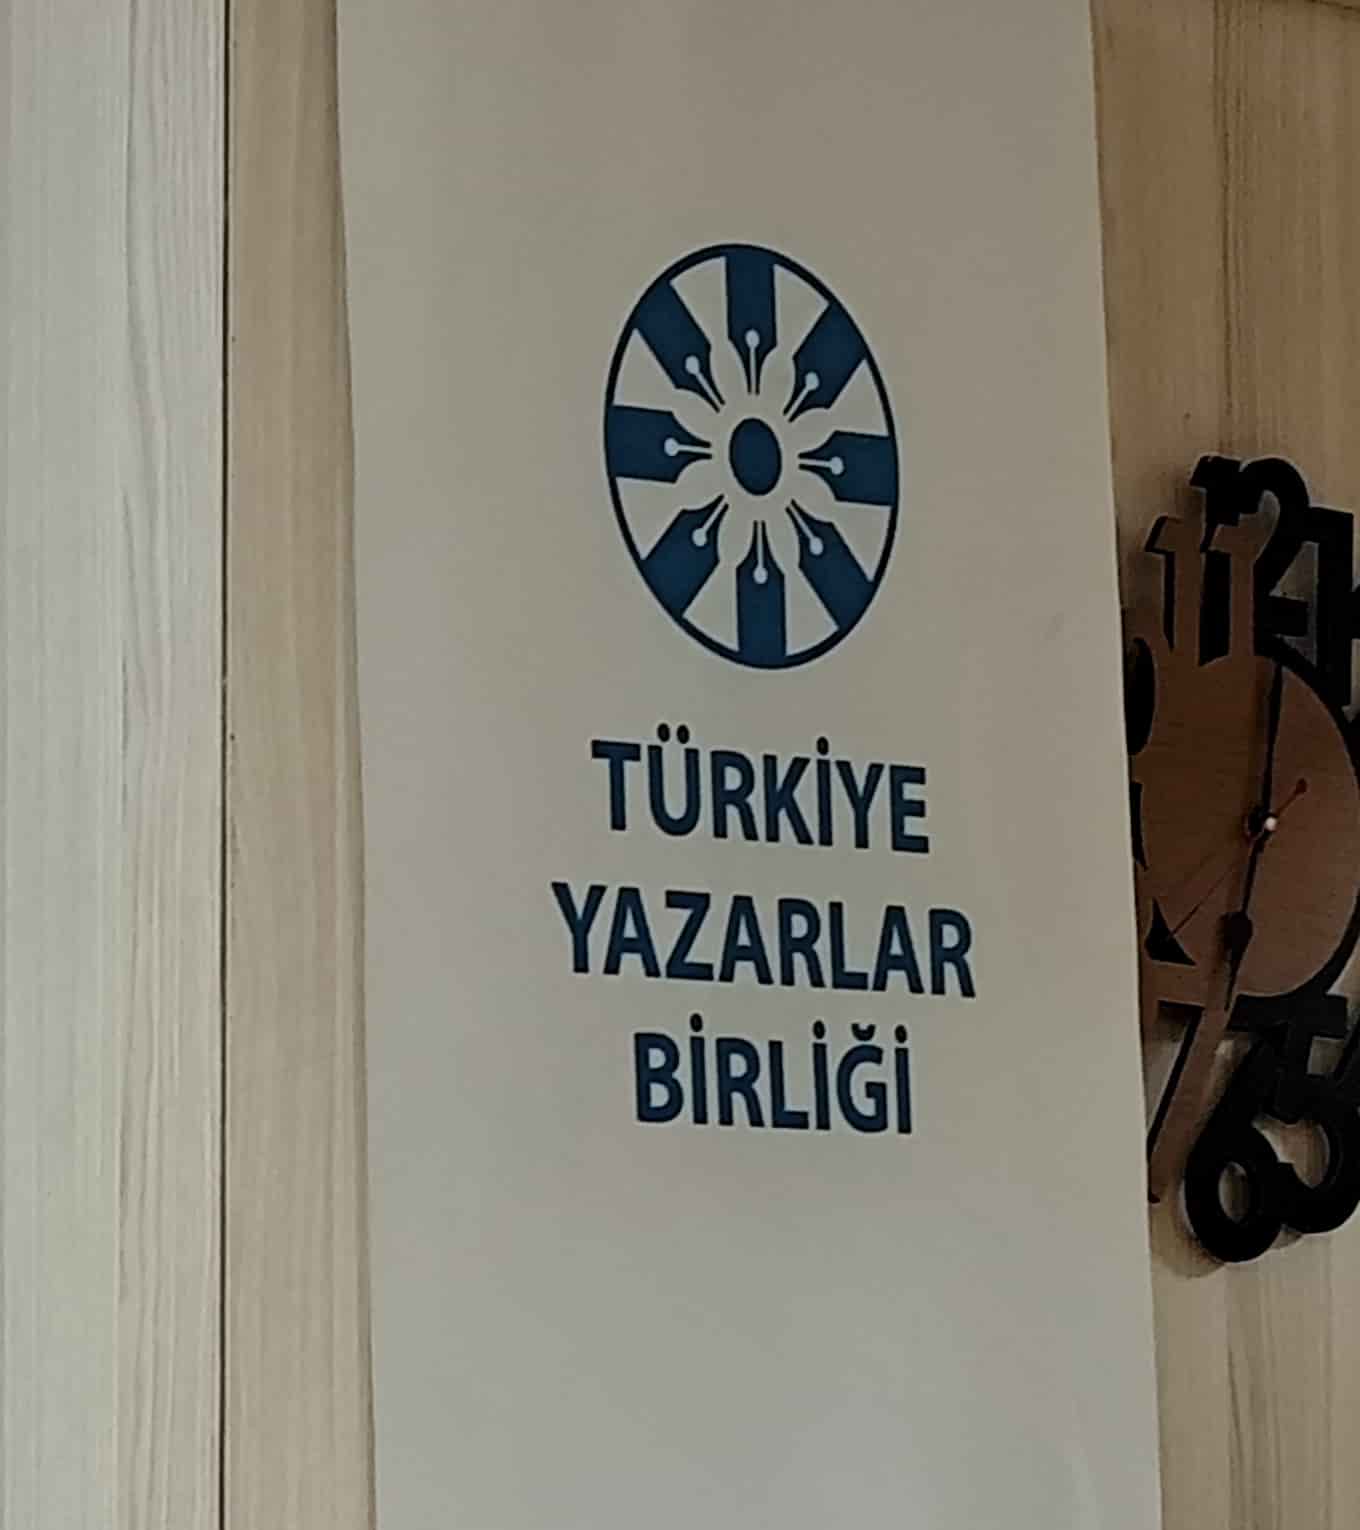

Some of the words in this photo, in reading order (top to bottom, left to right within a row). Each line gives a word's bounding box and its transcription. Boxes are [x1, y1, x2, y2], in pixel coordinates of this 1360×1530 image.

[591, 723, 930, 854] TÜRKİYE
[551, 881, 977, 998] YAZARLAR
[634, 1012, 913, 1135] BİRLİĞİ
